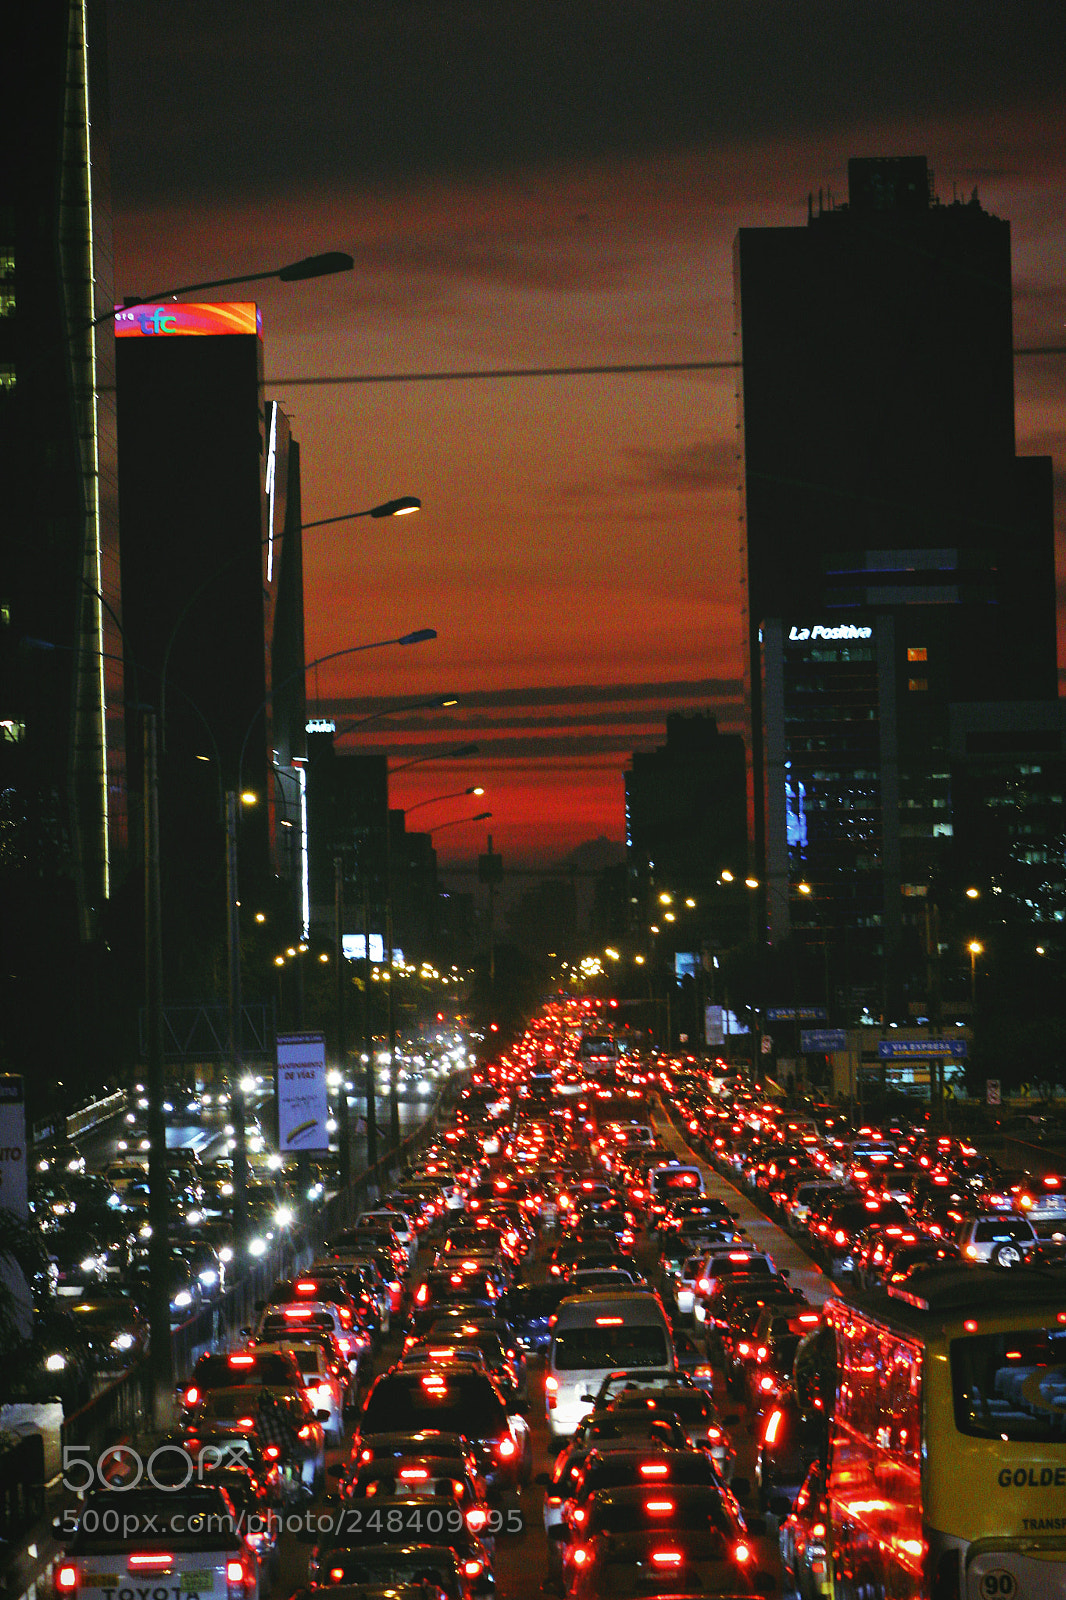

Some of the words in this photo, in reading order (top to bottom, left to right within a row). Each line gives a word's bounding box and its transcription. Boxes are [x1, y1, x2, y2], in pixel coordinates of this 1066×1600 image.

[137, 307, 177, 335] tfc
[788, 626, 811, 641] La
[810, 624, 873, 640] Positiva
[891, 1043, 908, 1051] VIA
[998, 1467, 1066, 1488] GOLDE
[985, 1574, 1014, 1595] 90
